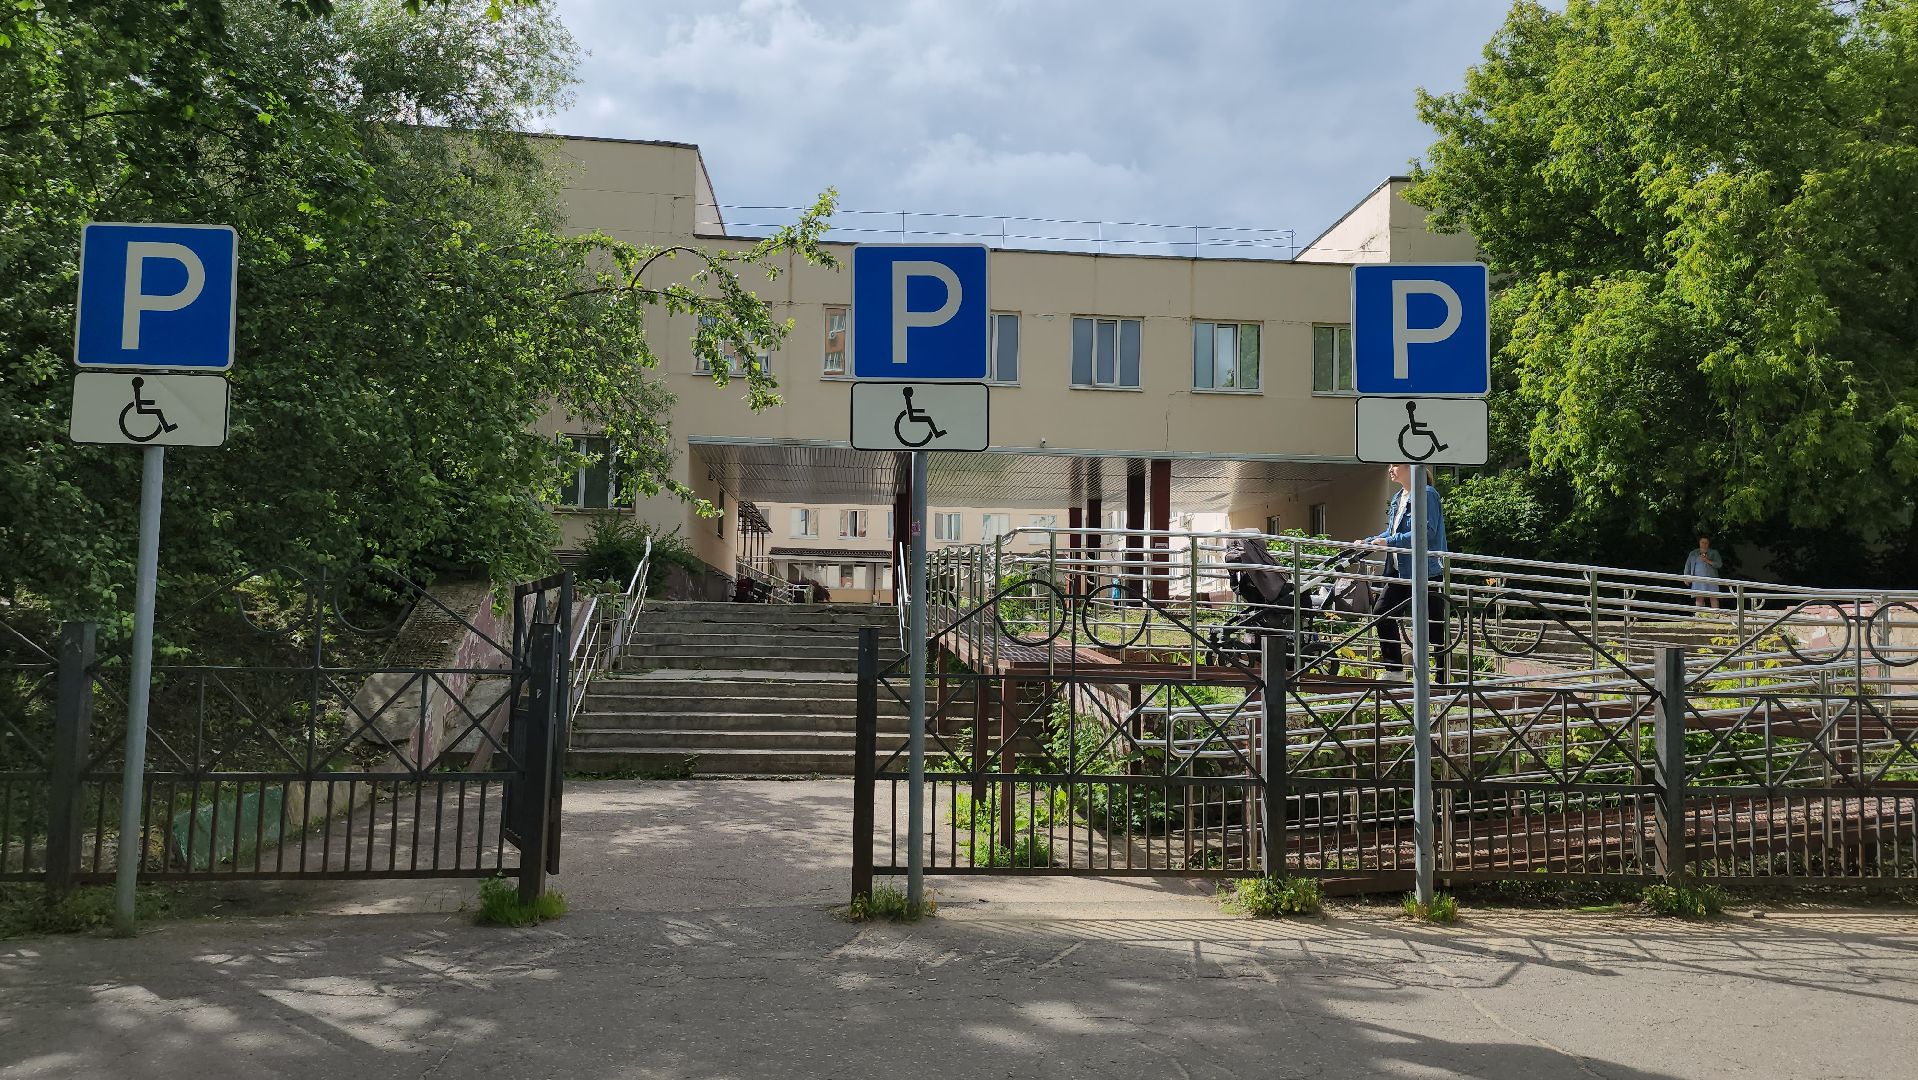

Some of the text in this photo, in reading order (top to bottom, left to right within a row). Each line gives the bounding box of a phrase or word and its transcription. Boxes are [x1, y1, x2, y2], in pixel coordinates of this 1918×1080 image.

[122, 242, 205, 349] P
[892, 261, 962, 363] P
[1392, 280, 1462, 379] P
